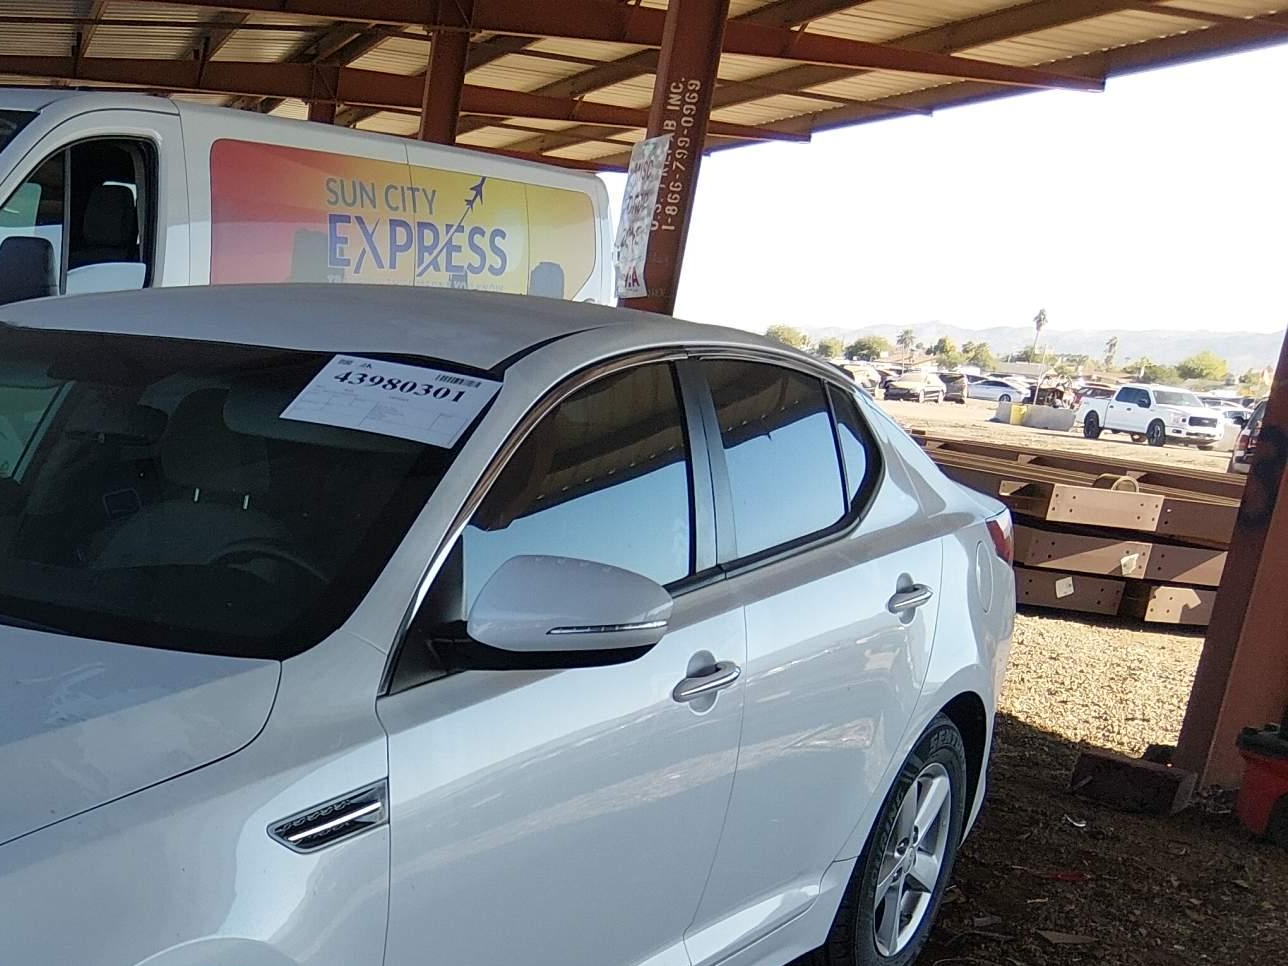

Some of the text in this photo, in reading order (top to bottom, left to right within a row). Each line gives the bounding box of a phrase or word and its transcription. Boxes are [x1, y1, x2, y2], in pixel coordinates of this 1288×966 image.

[667, 77, 686, 111] INC.
[661, 79, 701, 232] 1-866-799-0969
[326, 177, 437, 216] SUN CITY
[327, 213, 508, 278] EXPRESS
[332, 370, 467, 404] 43980301
